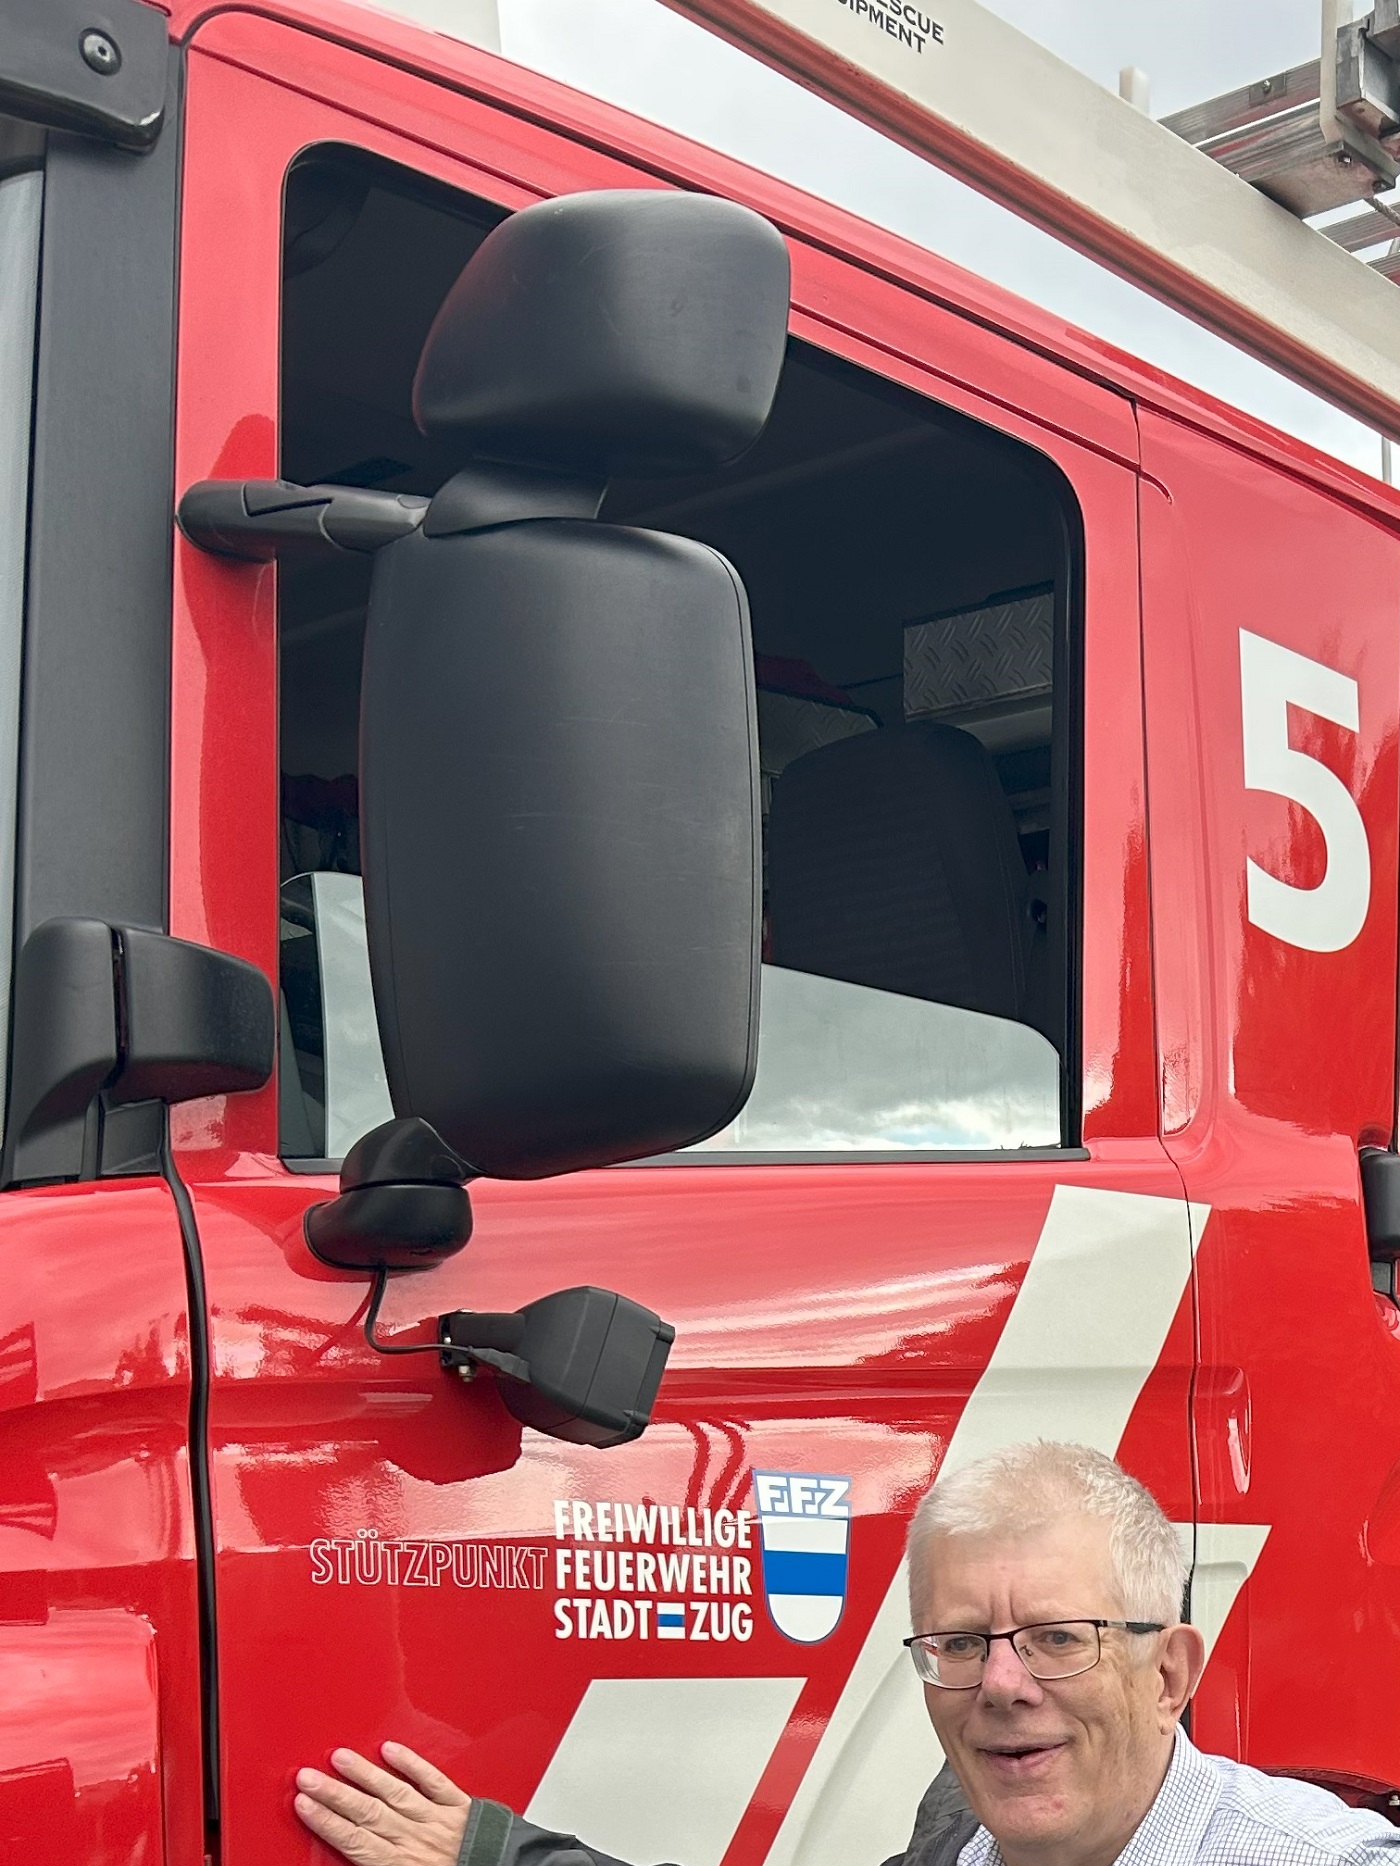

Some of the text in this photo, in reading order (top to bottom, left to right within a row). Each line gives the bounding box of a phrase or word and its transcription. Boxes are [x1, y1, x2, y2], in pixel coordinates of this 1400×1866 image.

[1238, 627, 1372, 953] 5
[755, 1475, 850, 1515] FFZ
[553, 1499, 752, 1549] FREIWILLIGE
[309, 1528, 549, 1590] STÜTZPUNKT
[555, 1549, 753, 1596] FEUERWEHR
[554, 1598, 754, 1642] STADT ZUG
